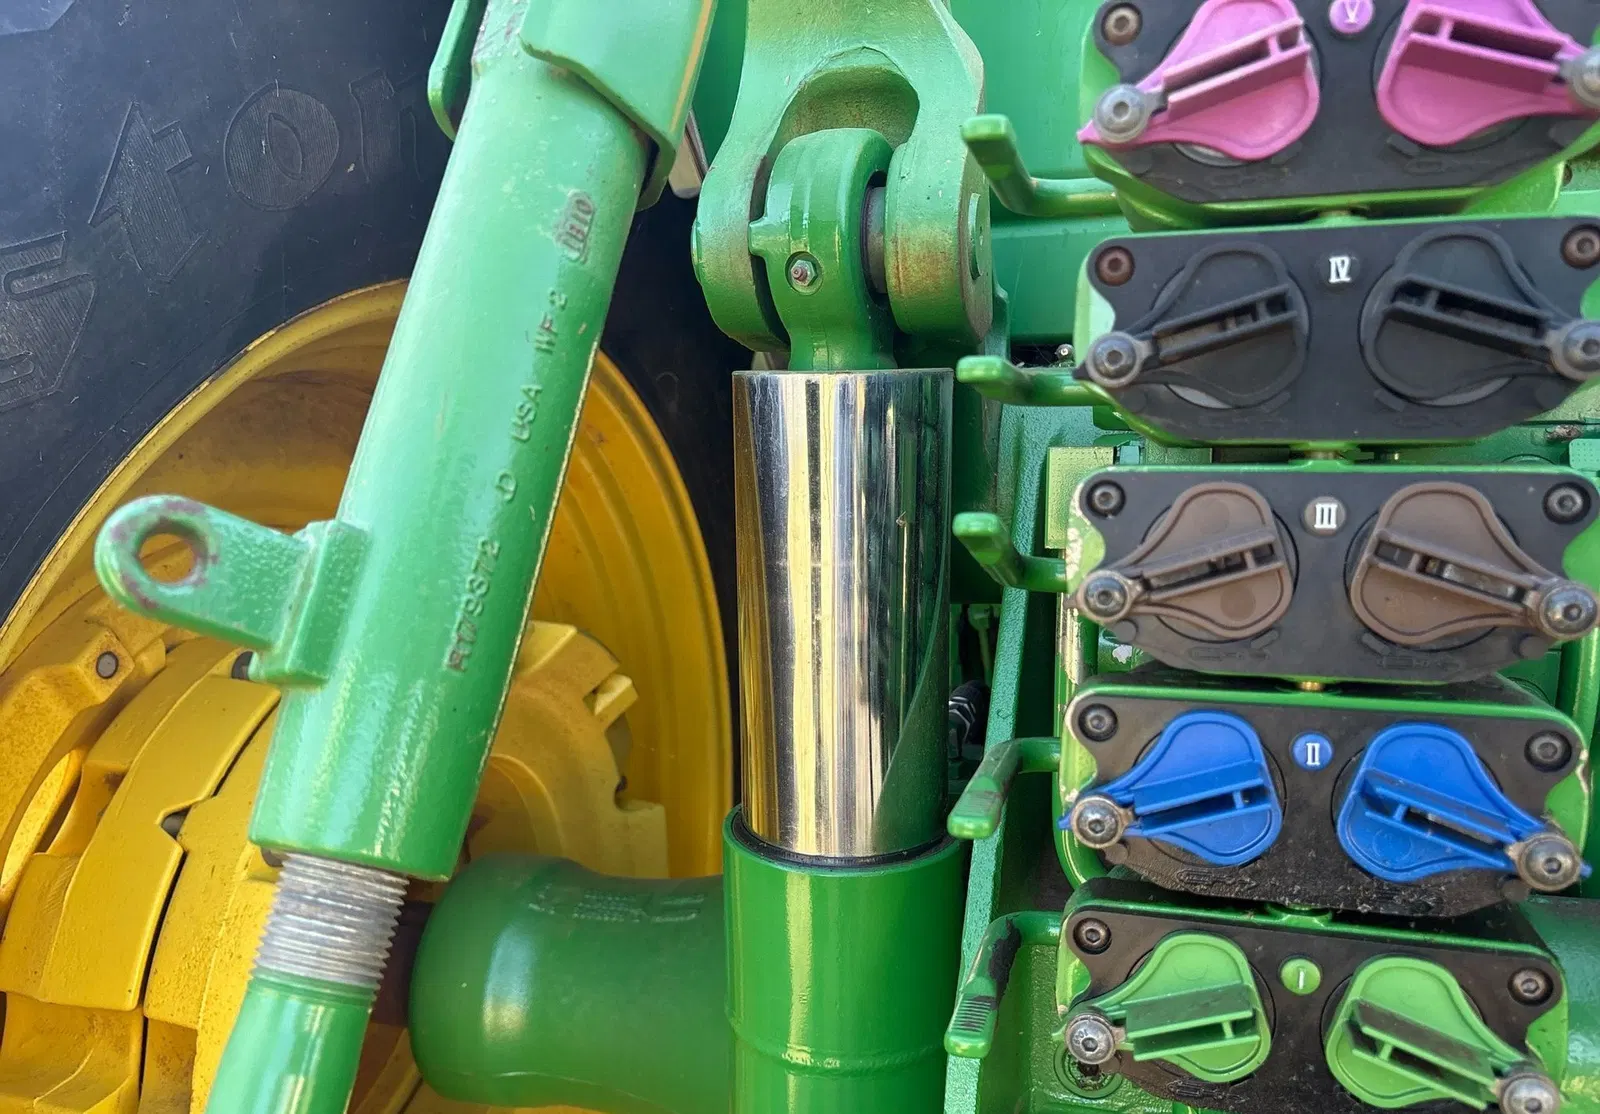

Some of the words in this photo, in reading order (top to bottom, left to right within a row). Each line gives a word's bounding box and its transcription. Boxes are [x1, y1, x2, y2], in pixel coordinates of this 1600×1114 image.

[1344, 0, 1361, 24] V
[1329, 256, 1350, 283] IV
[496, 470, 517, 501] D
[512, 384, 542, 443] USA
[549, 286, 568, 311] 2
[1314, 503, 1337, 529] III
[1306, 742, 1320, 766] II
[1298, 967, 1305, 990] I
